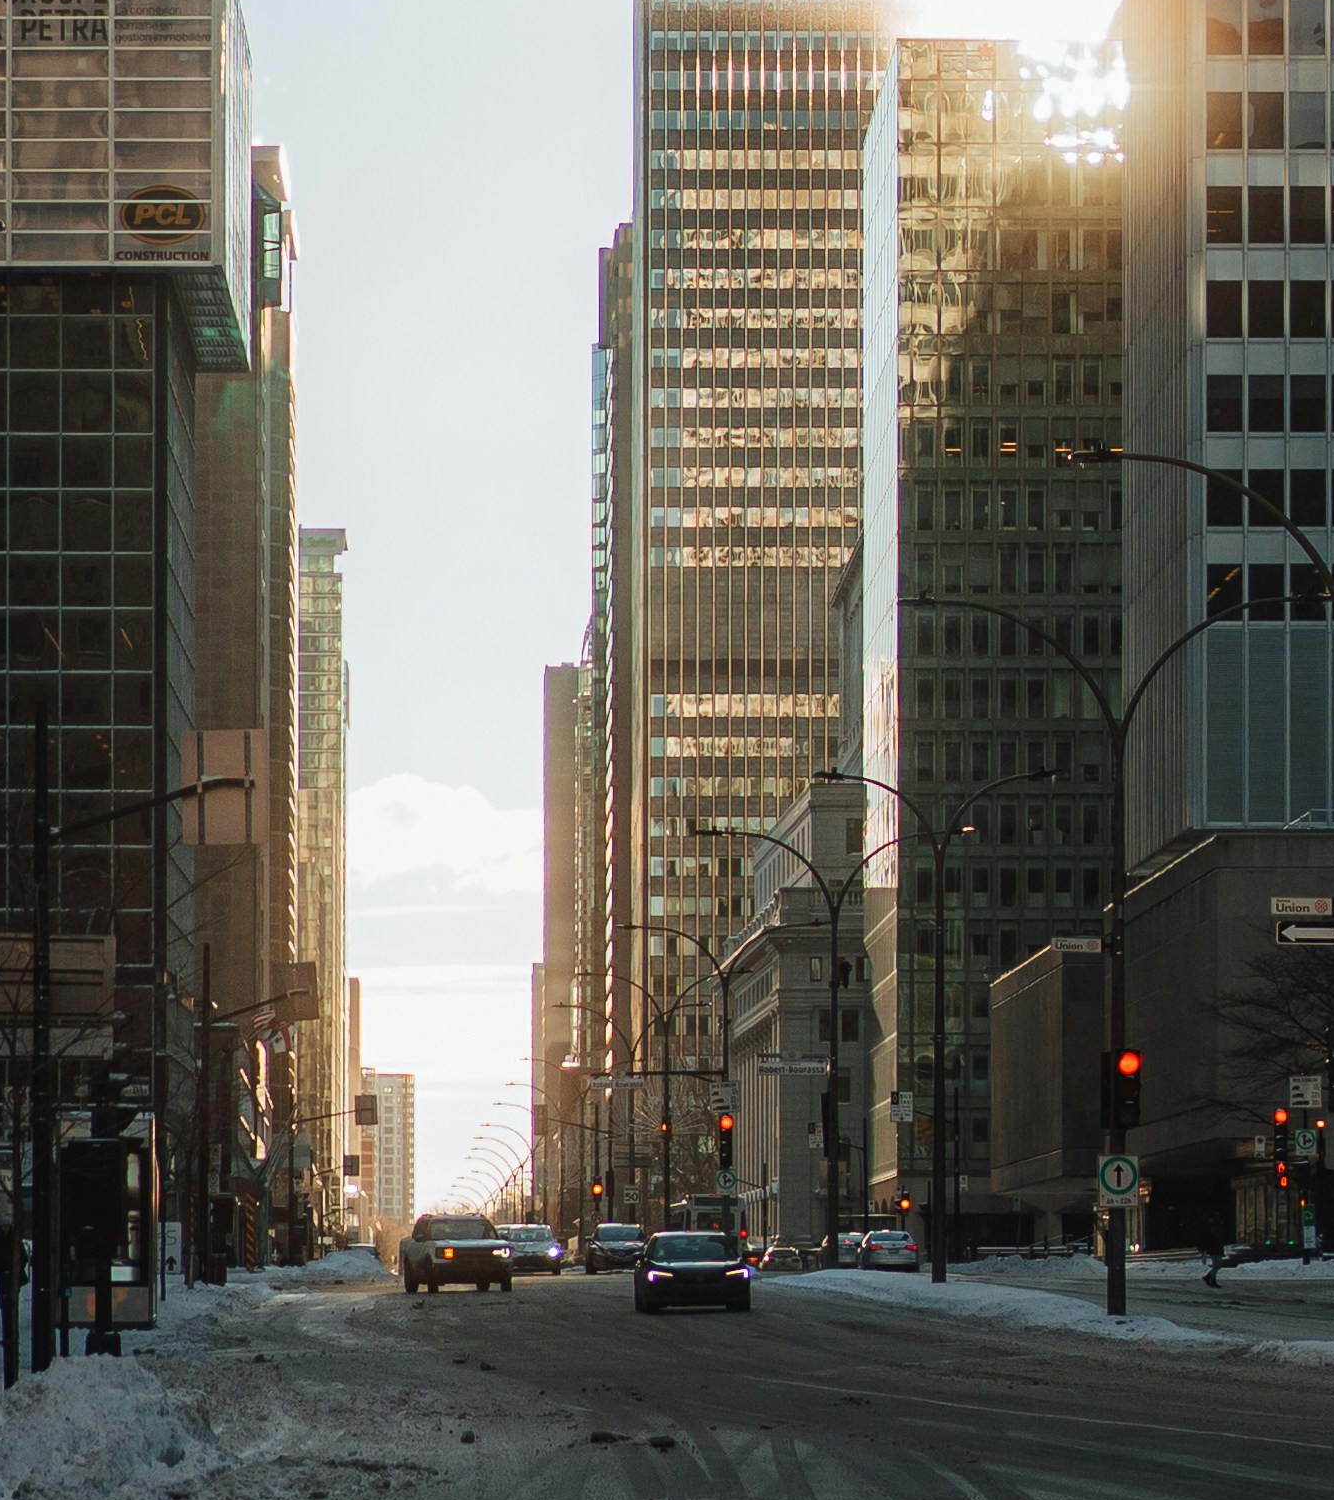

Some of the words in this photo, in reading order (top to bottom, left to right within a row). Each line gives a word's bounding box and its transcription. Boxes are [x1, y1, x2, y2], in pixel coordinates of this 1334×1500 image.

[21, 9, 108, 41] PETRA
[134, 204, 192, 225] PCL
[117, 251, 210, 261] CONSTRUCTION
[1275, 903, 1310, 912] Union
[1055, 942, 1084, 950] Union
[625, 1192, 639, 1202] 50
